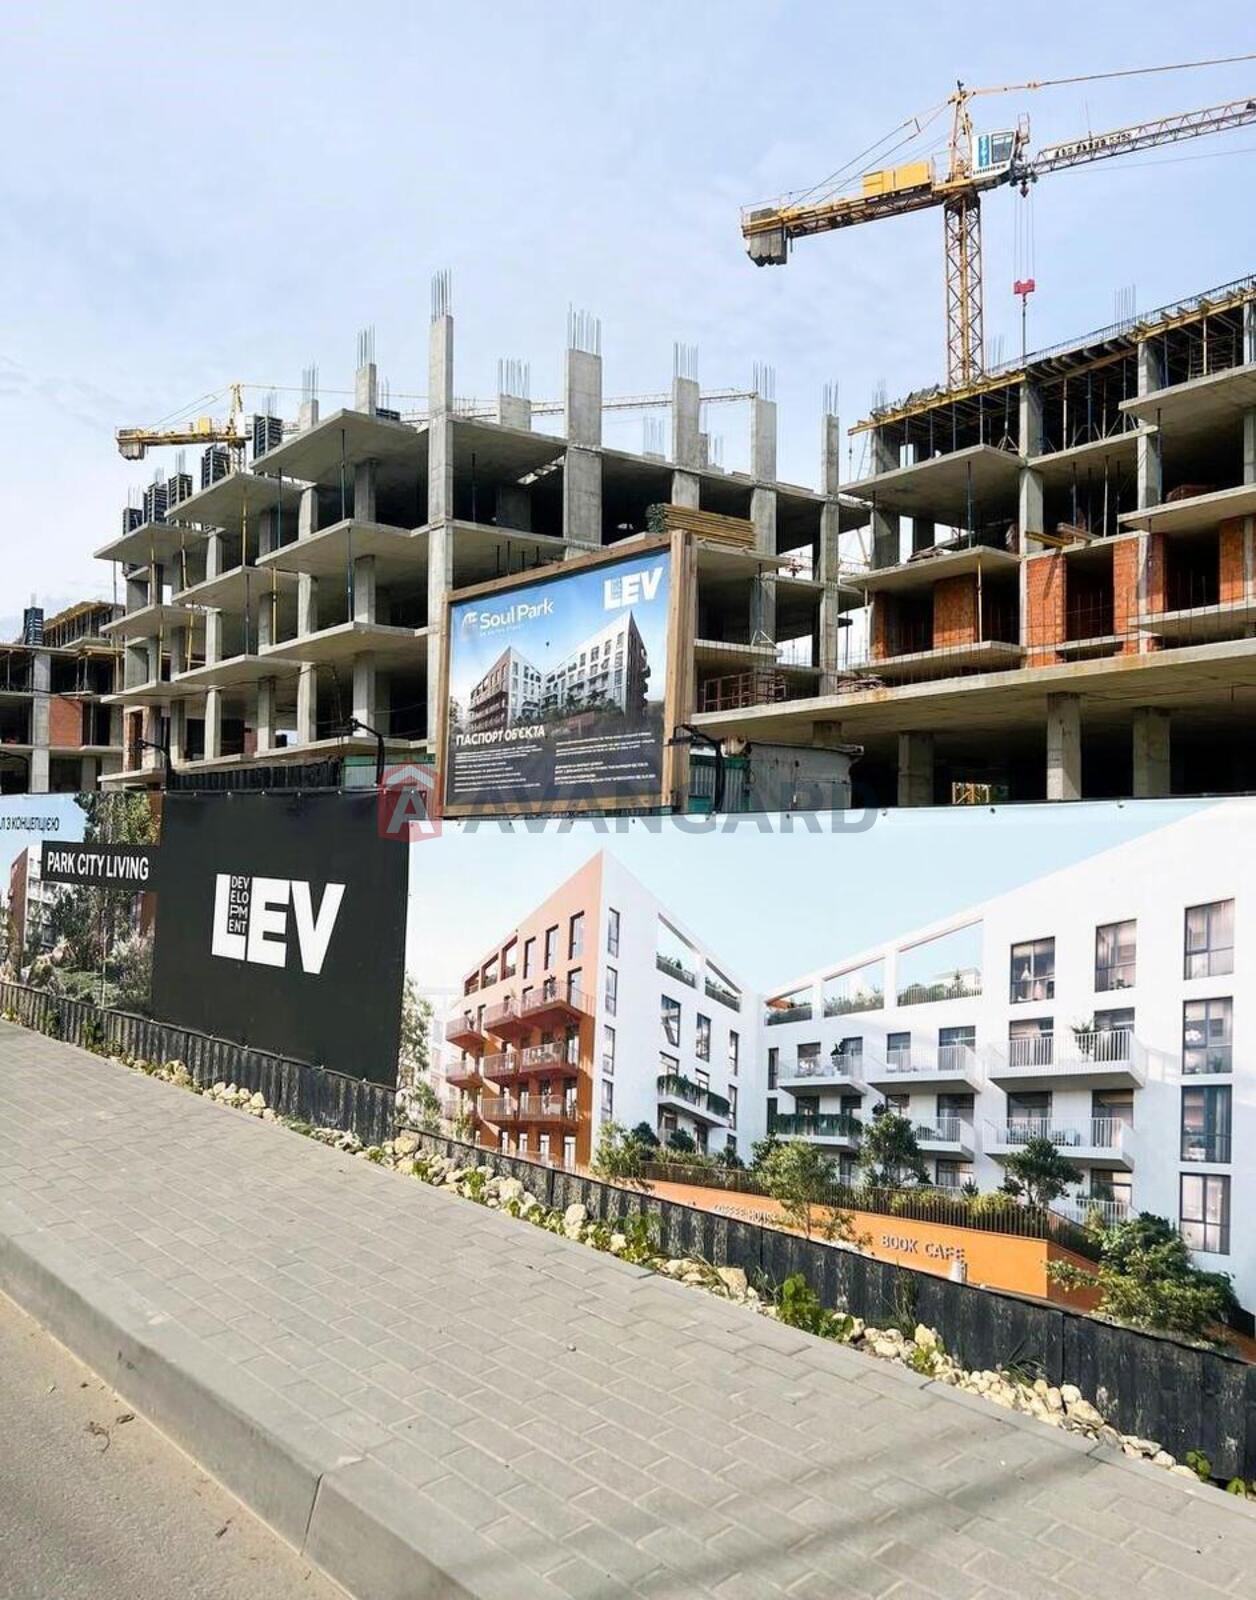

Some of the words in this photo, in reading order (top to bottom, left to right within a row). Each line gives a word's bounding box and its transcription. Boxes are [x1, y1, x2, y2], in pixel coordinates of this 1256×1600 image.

[604, 566, 664, 609] LEV
[480, 604, 516, 630] Soul
[517, 597, 554, 621] Park
[456, 730, 504, 746] ПАСПОРТ
[47, 851, 75, 874] PARK
[77, 854, 105, 876] CITY
[106, 855, 149, 881] LIVING
[212, 873, 346, 975] LEV
[882, 1235, 918, 1254] BOOK
[925, 1242, 965, 1261] CAFE
